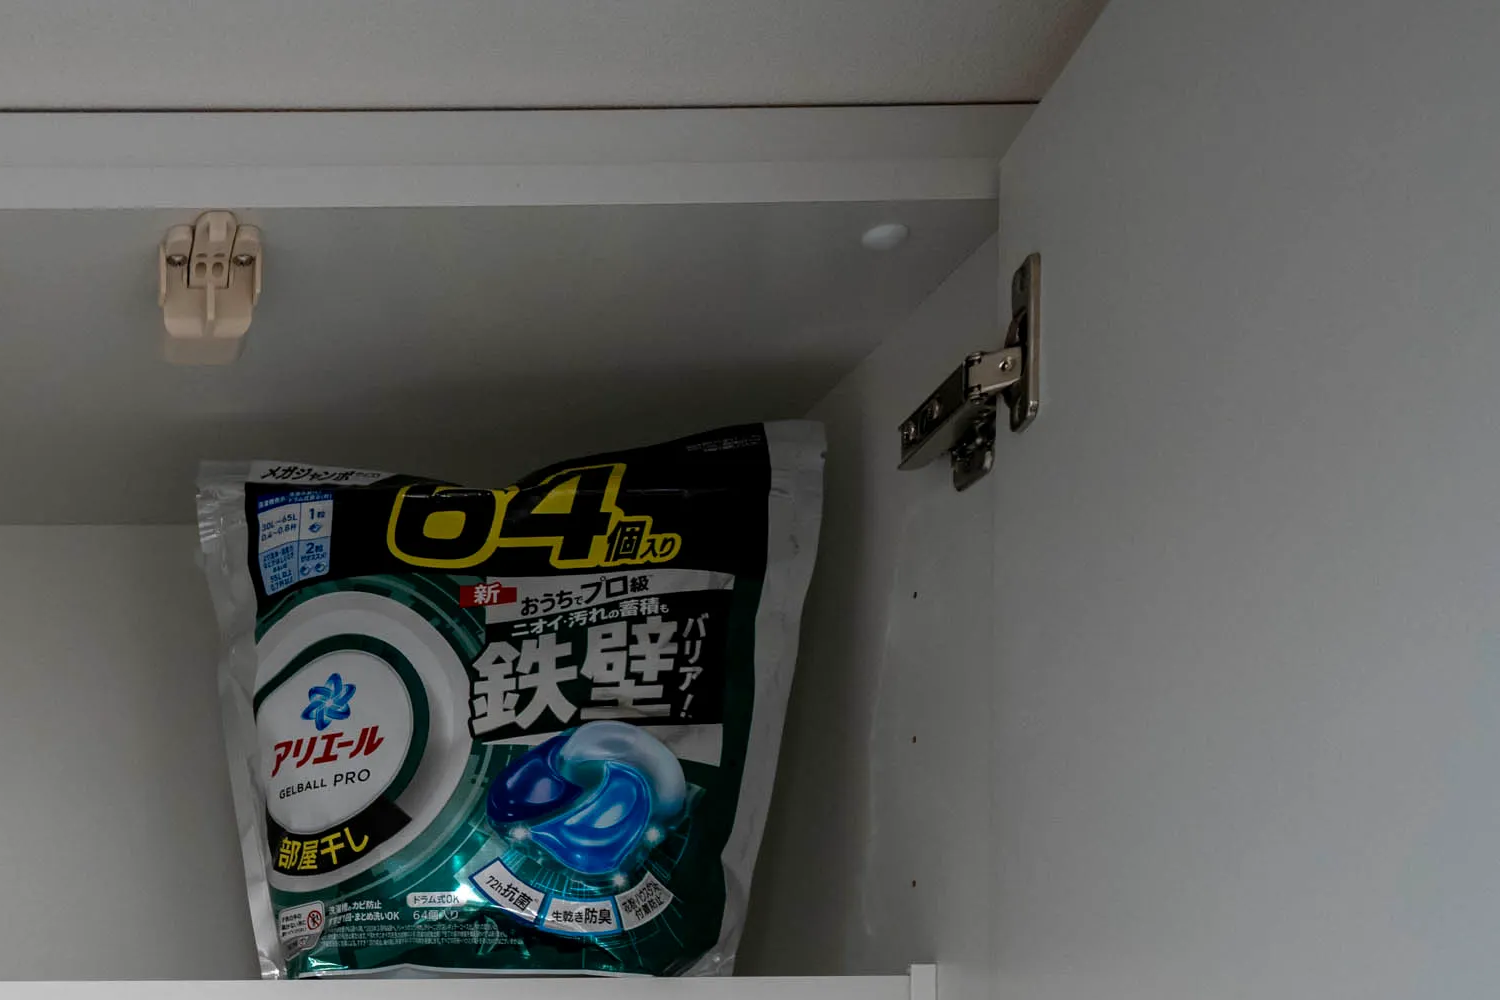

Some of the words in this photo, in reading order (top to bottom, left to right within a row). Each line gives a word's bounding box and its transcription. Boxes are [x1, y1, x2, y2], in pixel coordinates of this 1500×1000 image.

[474, 584, 501, 605] 新
[520, 575, 650, 616] おうちでプロ級
[471, 616, 679, 737] 鉄壁
[271, 725, 385, 777] アリエール
[279, 779, 328, 800] GELBALL
[333, 768, 371, 787] PRO
[277, 827, 370, 871] 部屋干し
[552, 907, 613, 925] 生乾き防臭
